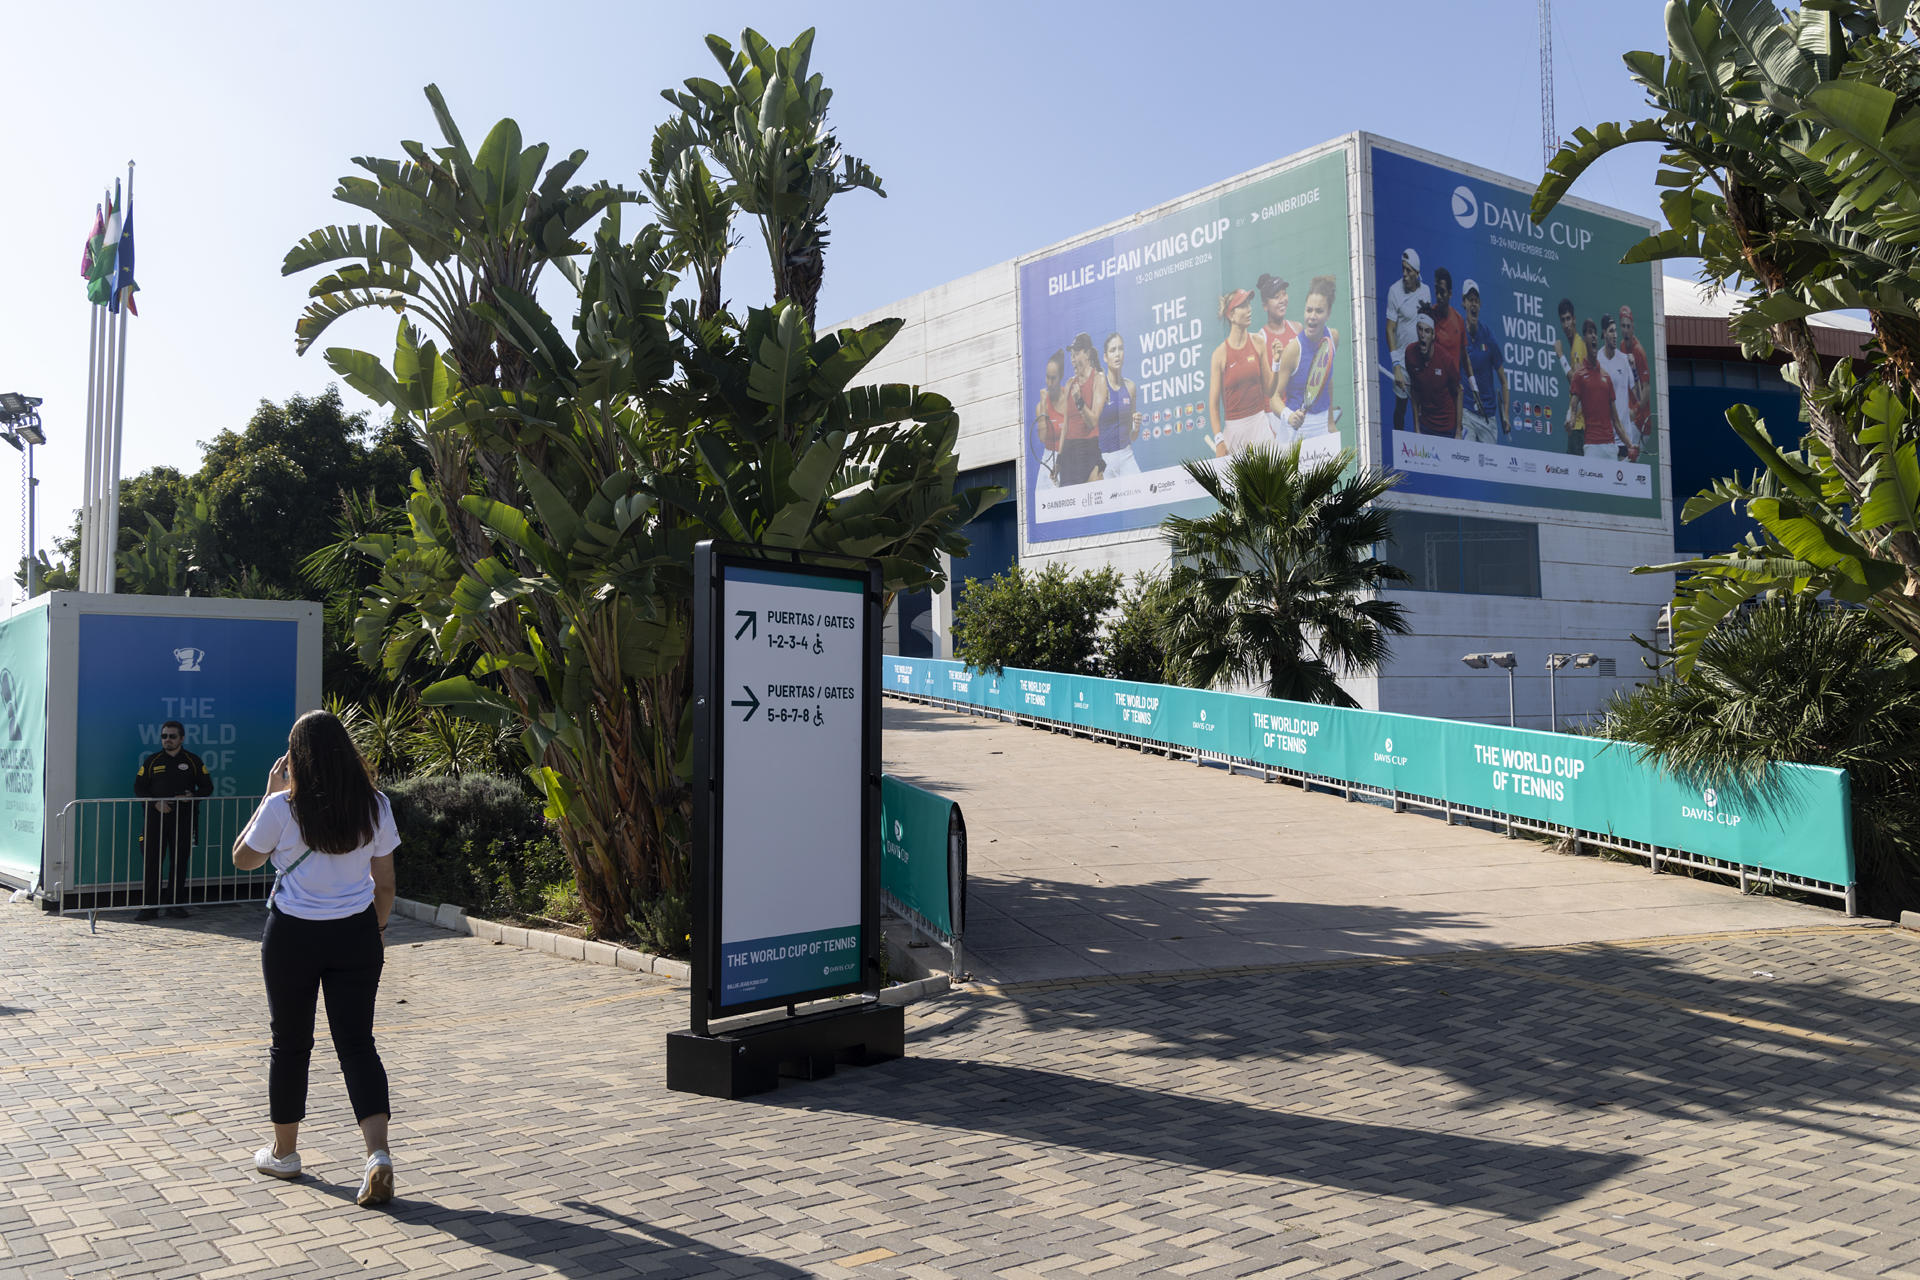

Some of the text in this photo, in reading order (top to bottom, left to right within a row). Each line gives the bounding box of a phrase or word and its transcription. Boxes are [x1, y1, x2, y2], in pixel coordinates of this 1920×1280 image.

[1048, 264, 1096, 297] BILLIE
[1096, 248, 1141, 281] JEAN
[1144, 232, 1189, 265] KING
[1190, 217, 1230, 249] CUP
[1261, 187, 1320, 220] GAINBRIDGE
[1550, 221, 1591, 251] CUP
[1507, 240, 1543, 257] NOVIEMBRE
[1153, 256, 1194, 279] NOVIEMBRE
[1151, 296, 1187, 324] THE
[1513, 291, 1544, 318] THE
[1139, 318, 1202, 354] WORLD
[1502, 315, 1556, 346] WORLD
[1141, 343, 1202, 379] CUP OF
[1504, 342, 1557, 371] CUP OF
[1140, 370, 1206, 404] TENNIS
[1503, 368, 1559, 398] TENNIS
[767, 610, 855, 630] PUERTAS / GATES
[768, 634, 808, 650] 1-2-3-4
[767, 684, 855, 700] PUERTAS / GATES
[1114, 692, 1159, 711] THE WORLD CUP
[161, 697, 215, 719] THE
[767, 708, 810, 722] 5-6-7-8
[1123, 708, 1152, 725] OF TENNIS
[137, 723, 237, 746] WRLD
[1253, 712, 1319, 737] THE WORLD CUP
[1263, 732, 1307, 754] OF TENNIS
[201, 750, 236, 772] OF
[1374, 752, 1408, 766] DAVIS CUP
[1474, 744, 1585, 780] THE WORLD CUP
[1493, 770, 1564, 802] OF TENNIS
[1682, 806, 1741, 827] DAVIS CUP
[727, 936, 857, 968] THE WORLD CUP OF TENNIS
